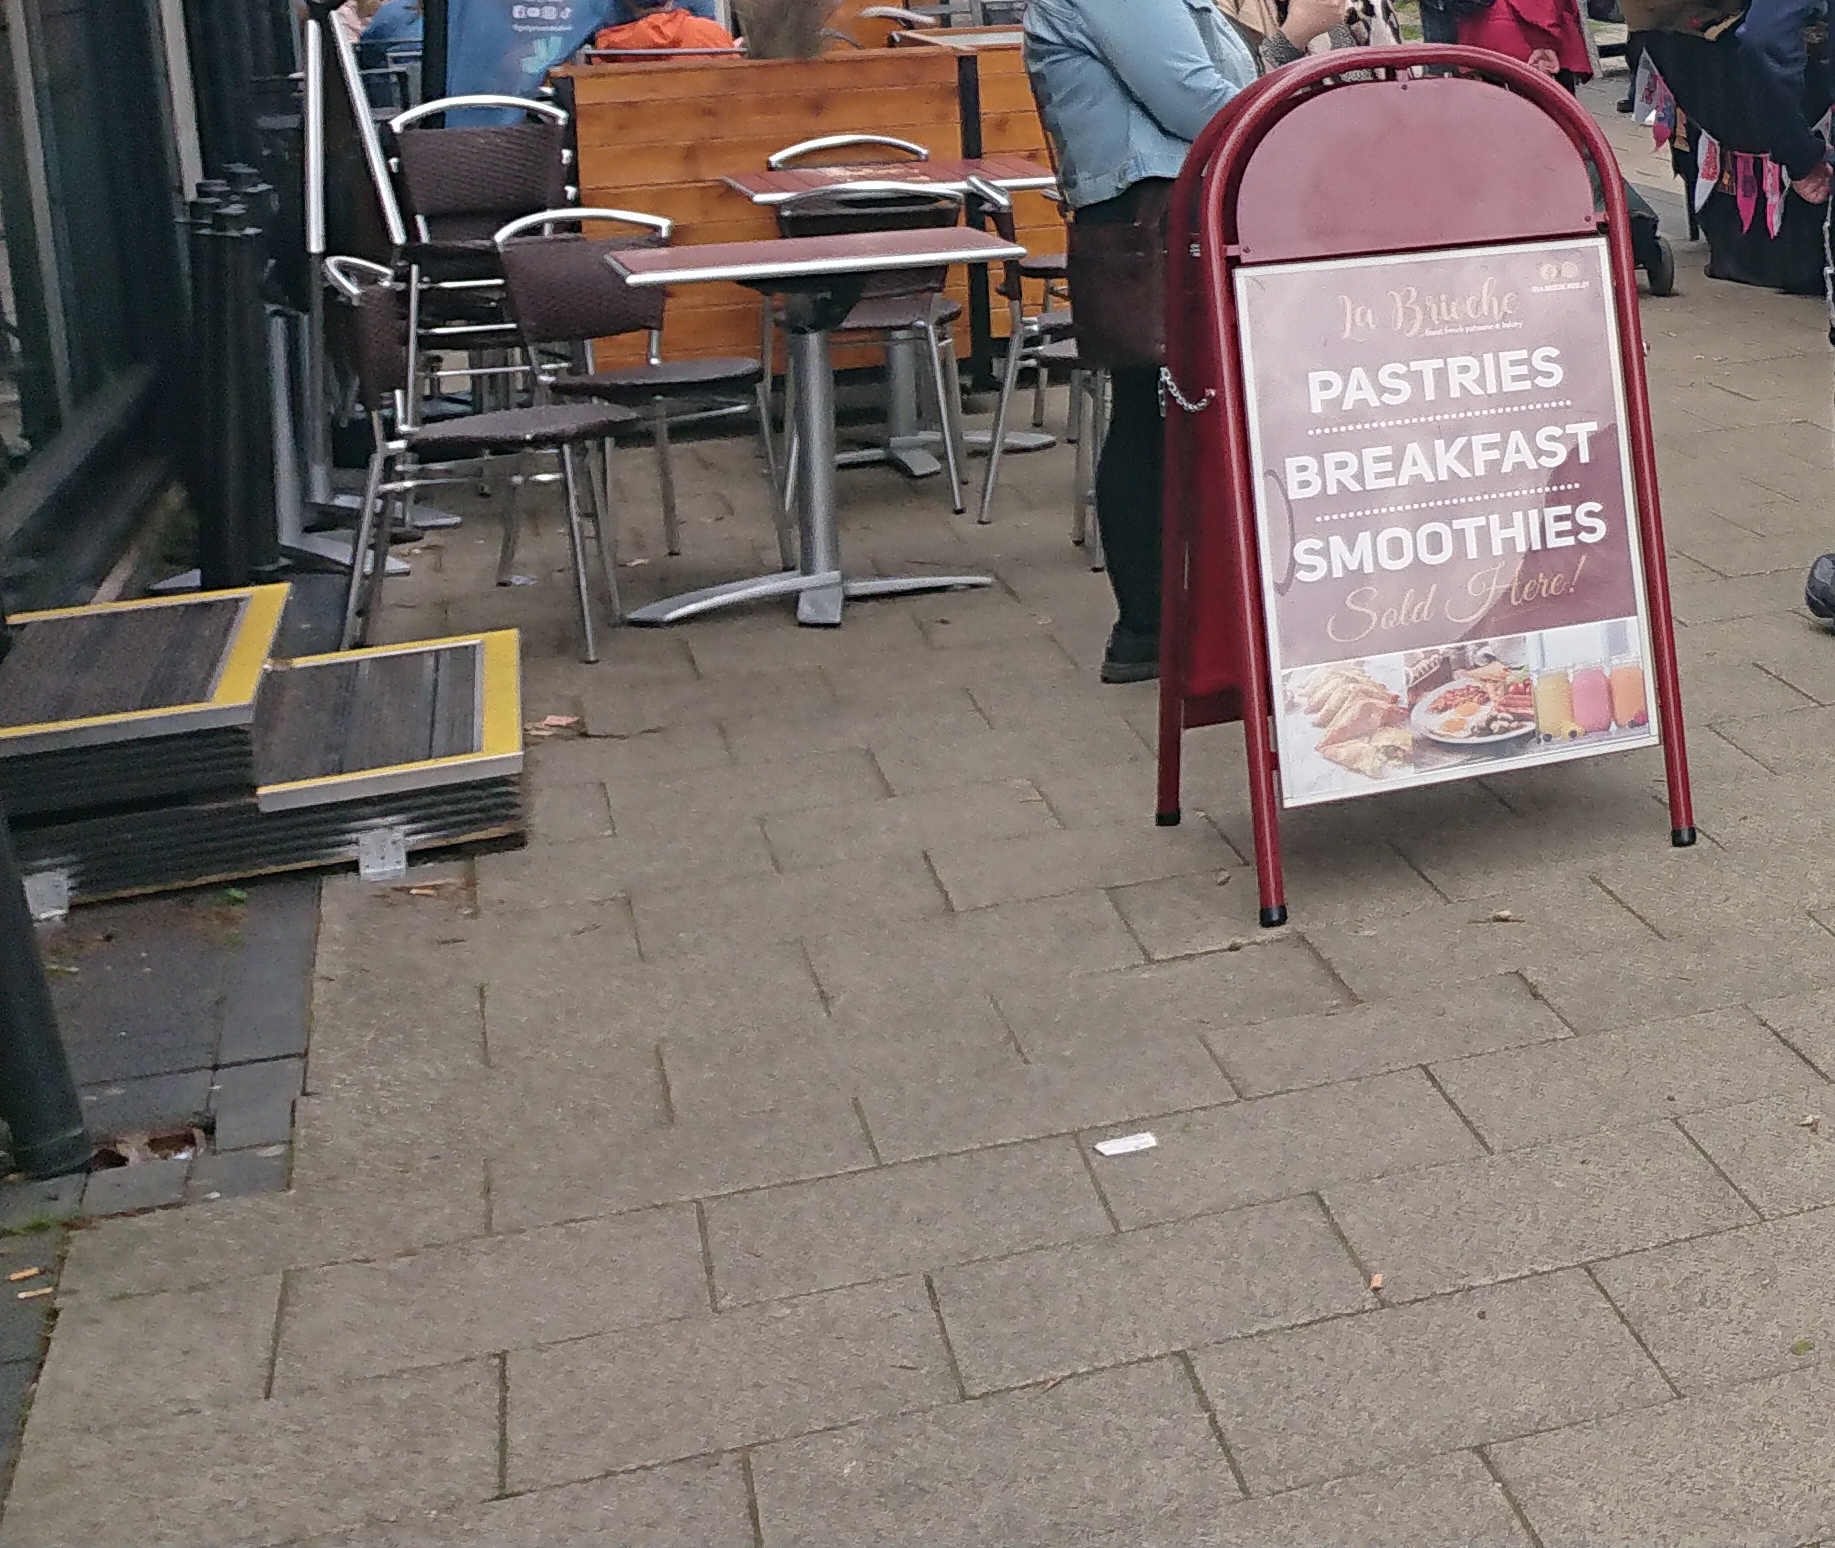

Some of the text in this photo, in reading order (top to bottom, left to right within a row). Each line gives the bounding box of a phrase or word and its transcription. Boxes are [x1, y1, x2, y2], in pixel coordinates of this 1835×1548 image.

[1307, 346, 1564, 414] PASTRIES
[1284, 421, 1599, 500] BREAKFAST
[1292, 501, 1607, 583] SMOOTHIES
[1326, 552, 1588, 643] Sold Here!
